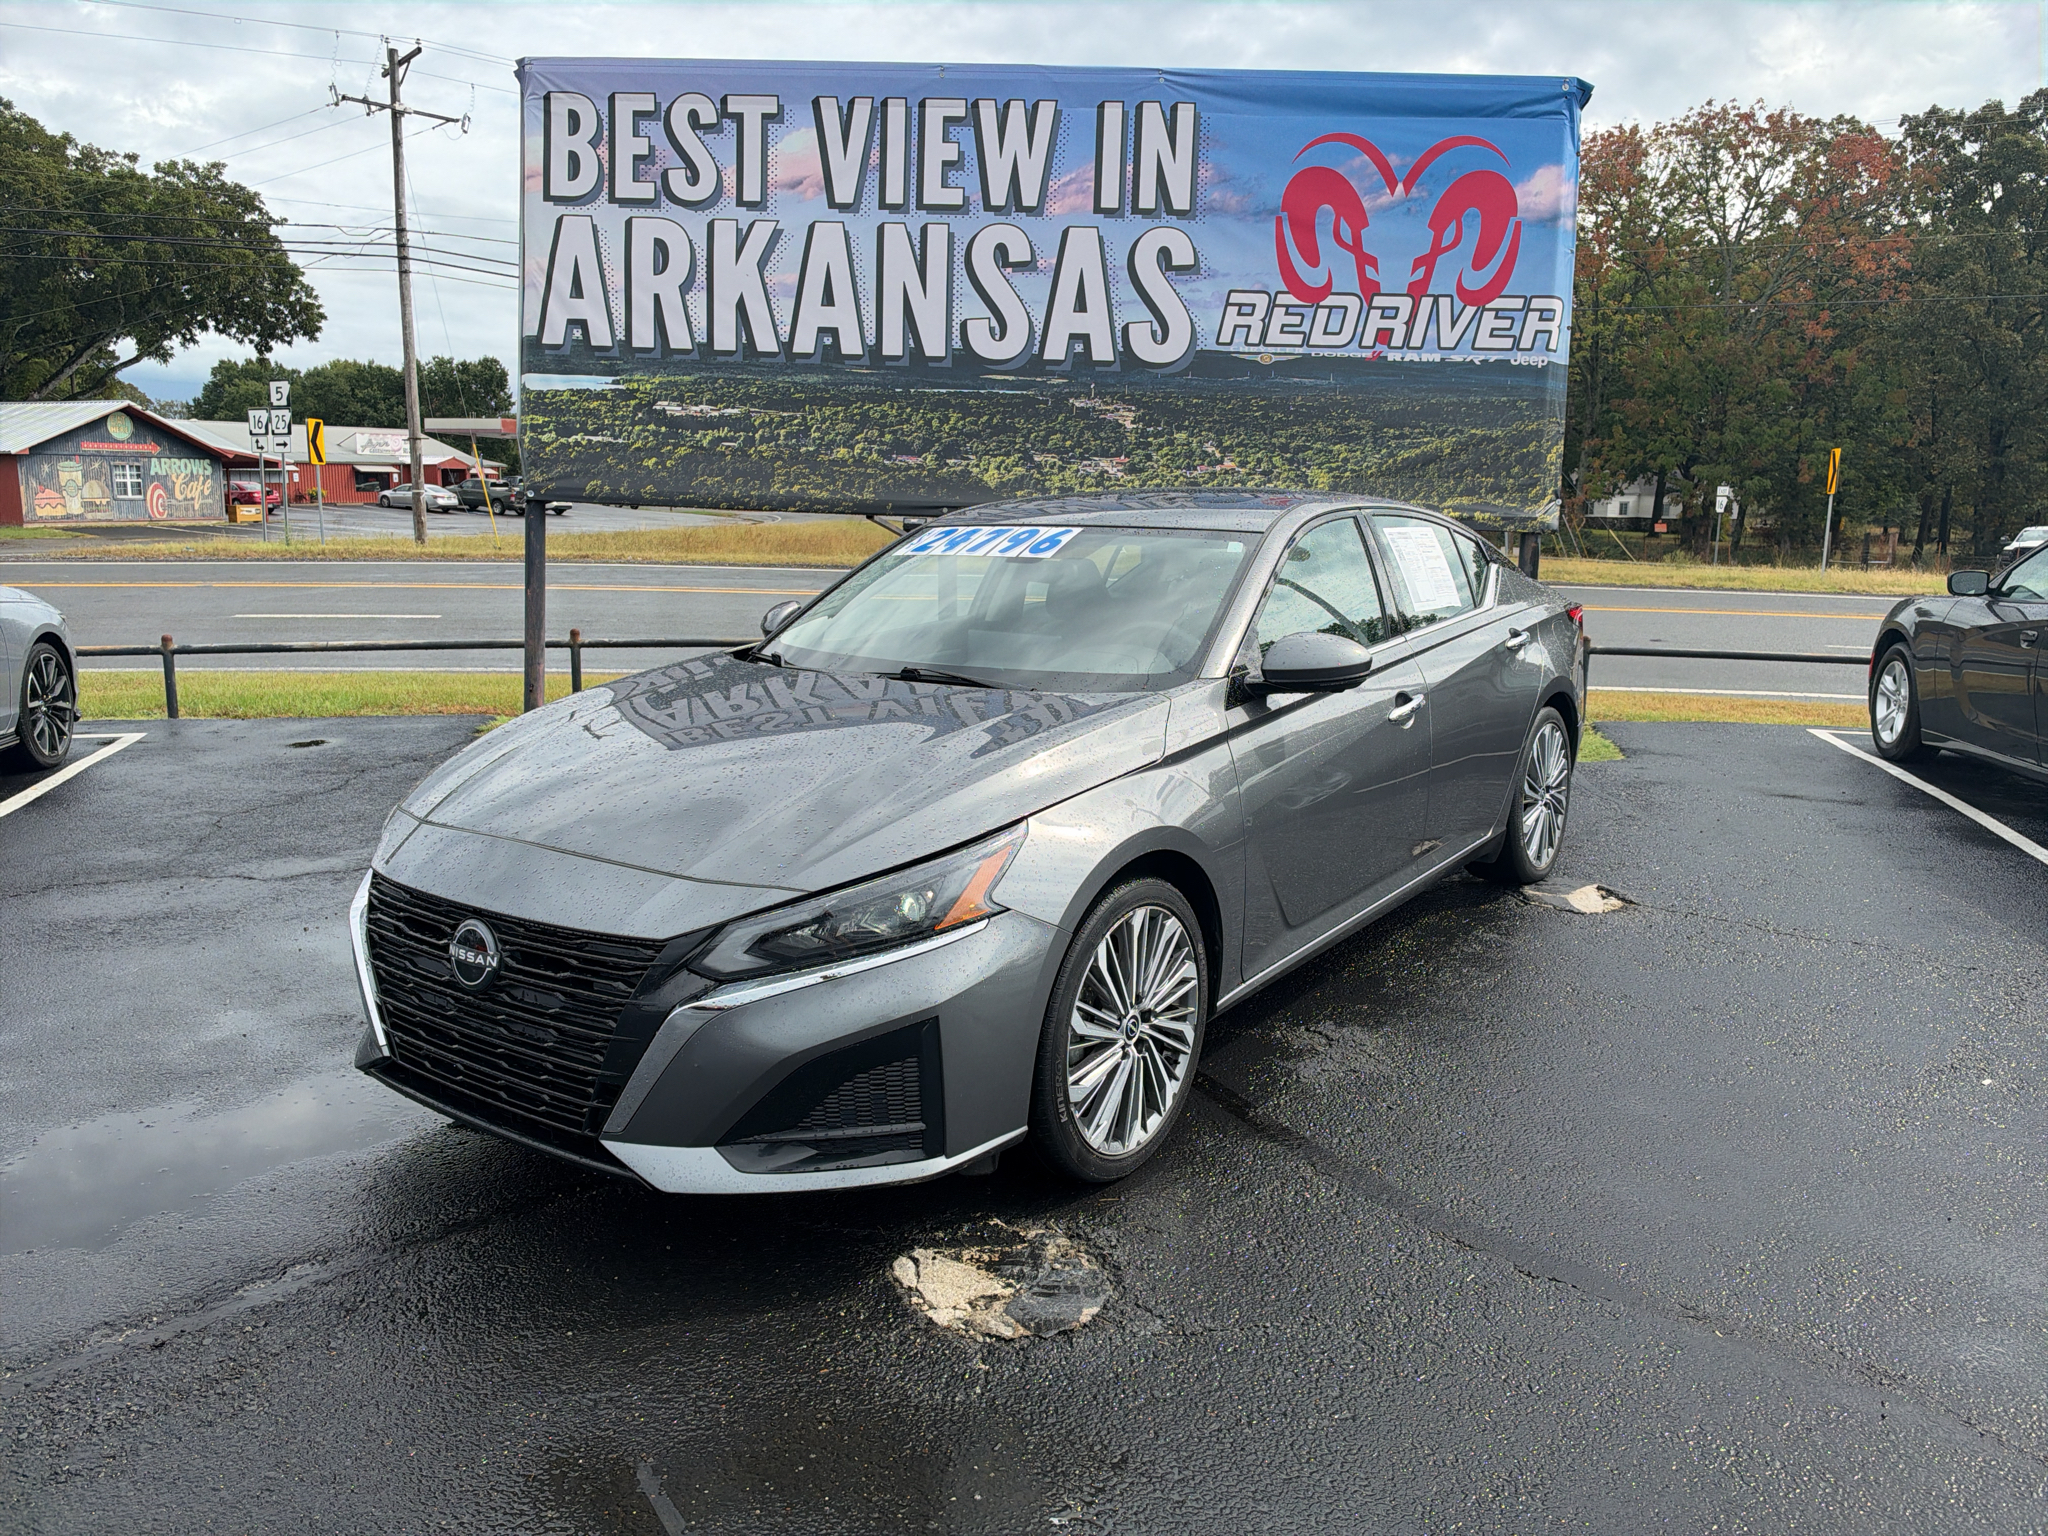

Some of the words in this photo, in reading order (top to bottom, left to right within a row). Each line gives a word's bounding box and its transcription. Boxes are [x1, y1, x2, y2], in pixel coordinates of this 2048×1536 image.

[543, 92, 780, 208] BEST
[812, 95, 1060, 213] VIEW
[1093, 98, 1197, 216] IN
[537, 214, 1198, 367] ARKANSAS
[1216, 289, 1564, 352] REDRIVER
[1311, 351, 1374, 359] DODGE
[1387, 352, 1441, 362] RAM
[1445, 354, 1504, 365] SRT
[1510, 352, 1548, 368] Jeep
[275, 386, 283, 401] 5
[253, 415, 263, 430] 16
[275, 414, 287, 430] 25
[150, 458, 212, 475] ARROWS
[171, 473, 212, 510] Cafe
[1717, 499, 1724, 510] 16
[449, 943, 498, 967] NISSAN
